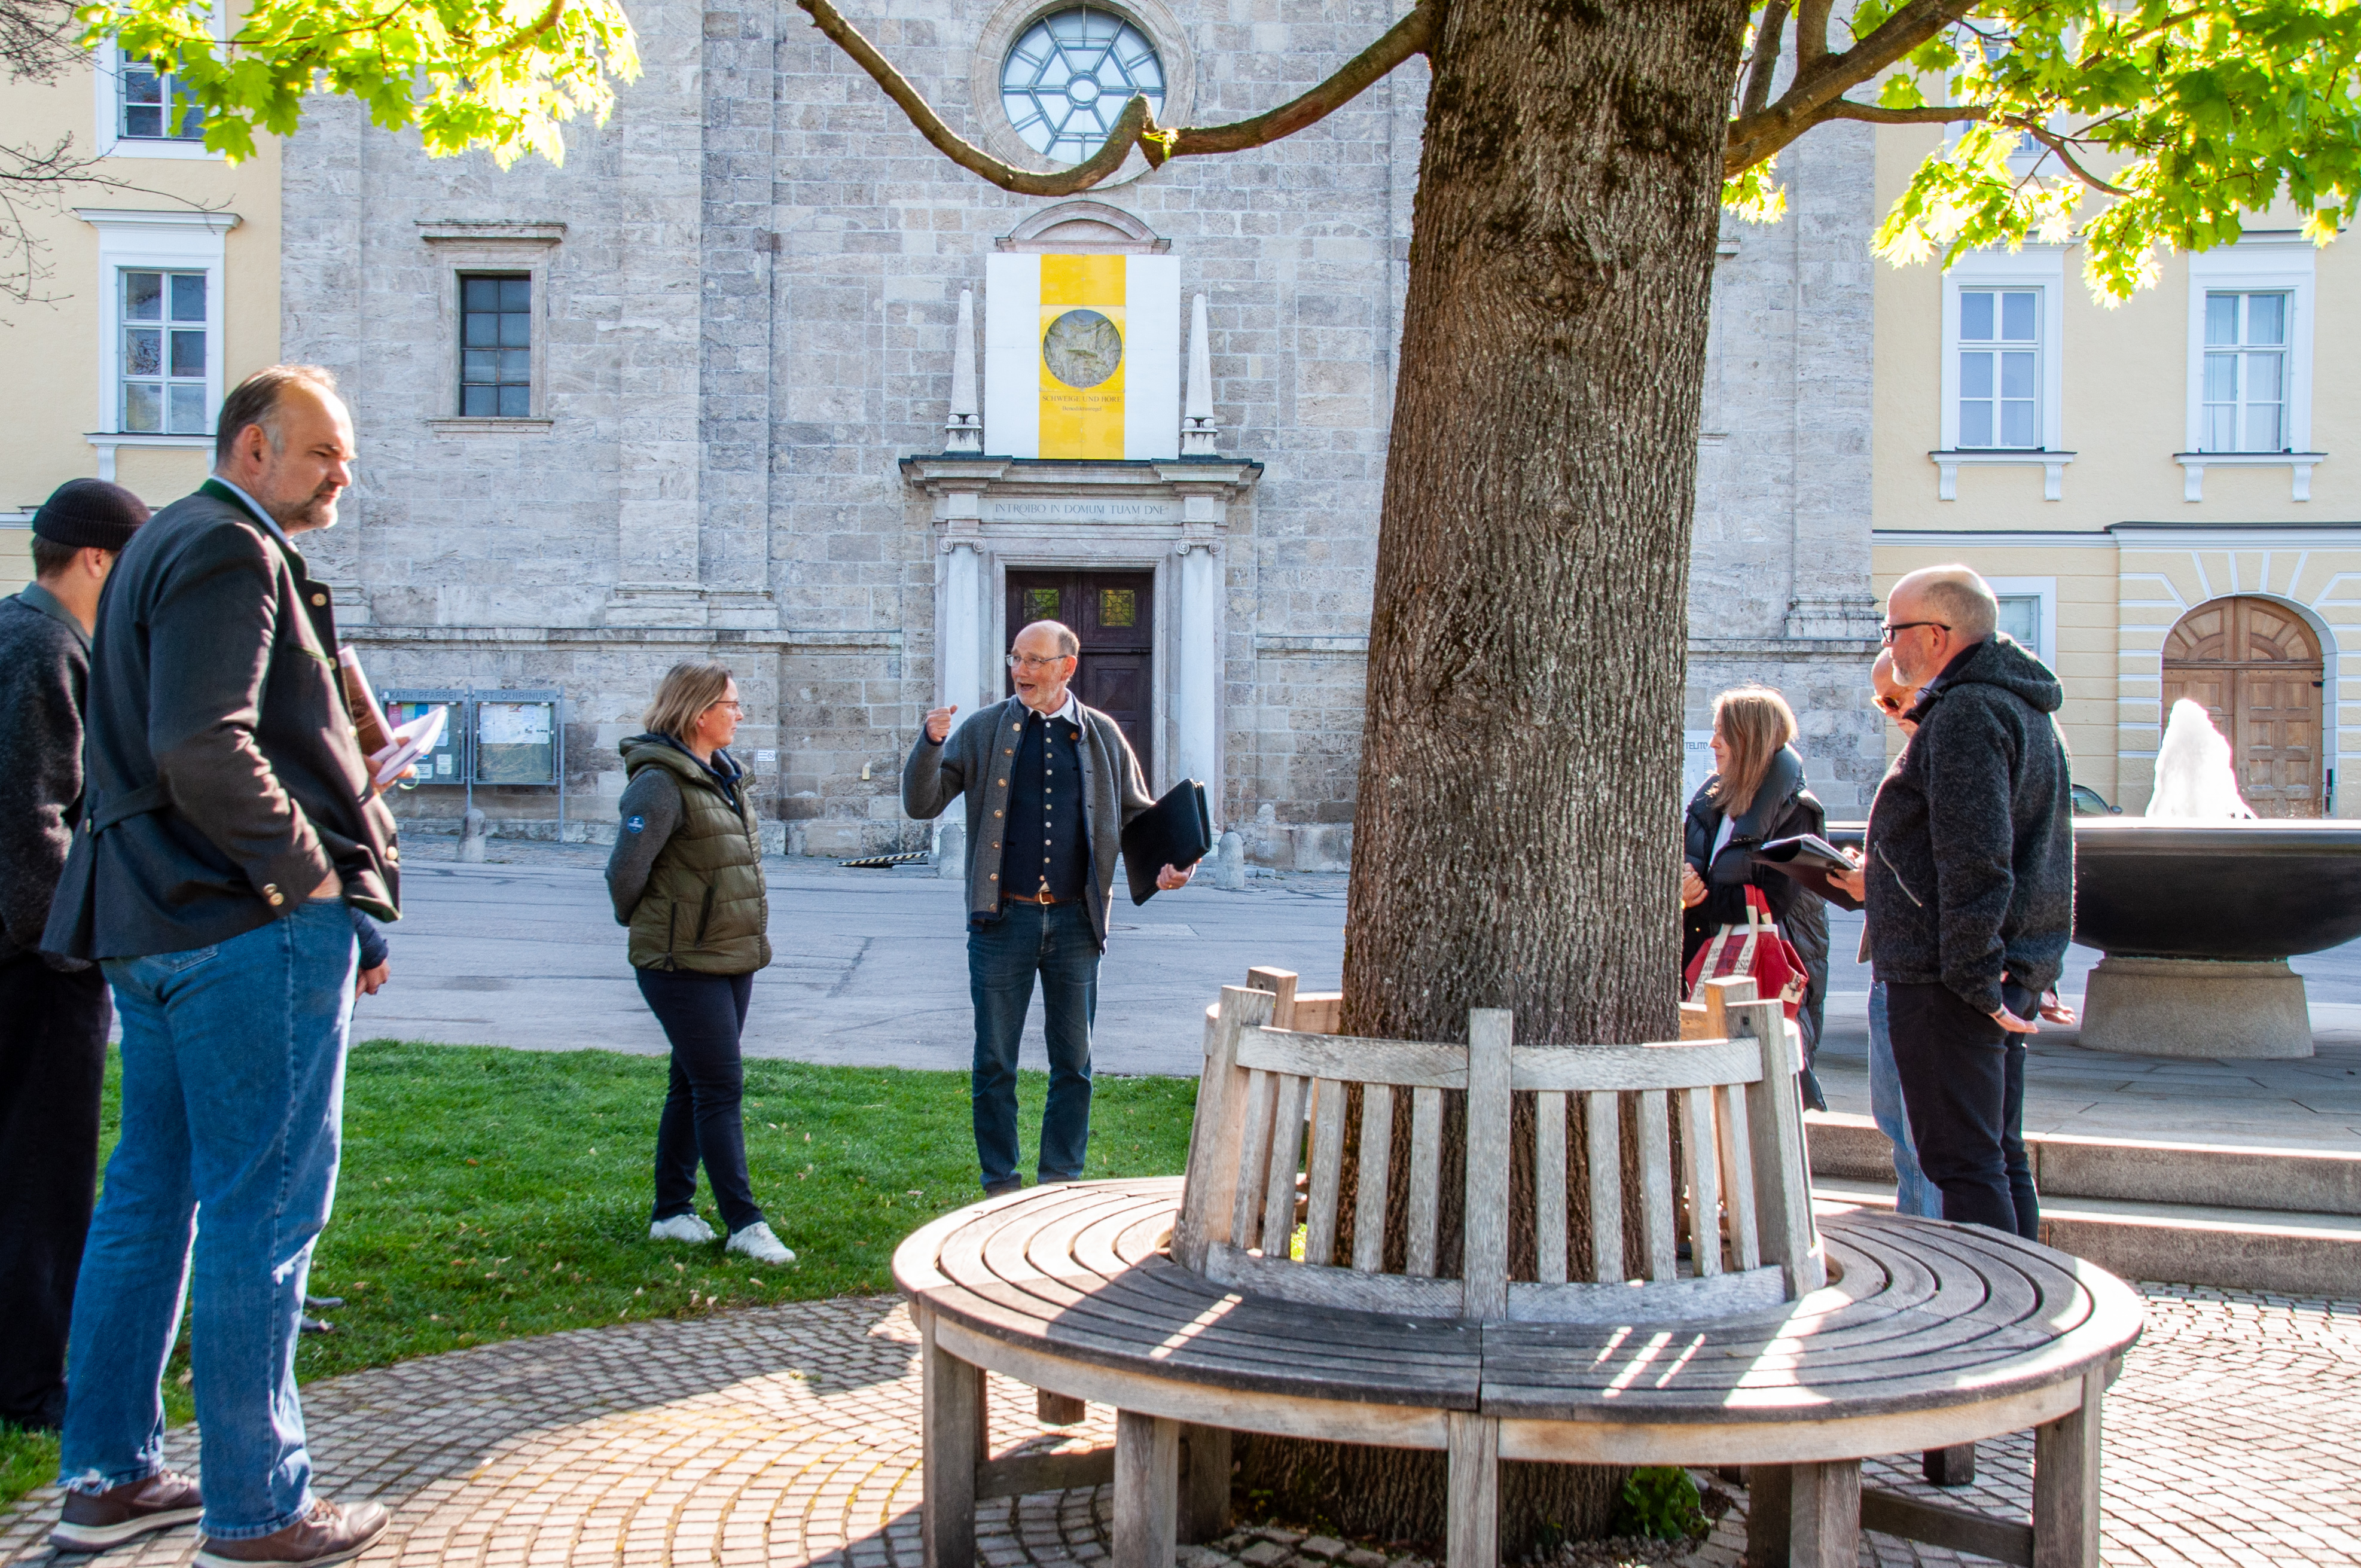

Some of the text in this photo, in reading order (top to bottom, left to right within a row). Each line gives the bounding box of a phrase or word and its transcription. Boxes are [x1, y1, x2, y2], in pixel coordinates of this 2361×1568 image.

[995, 503, 1047, 517] INTROIBO
[1050, 504, 1060, 513] IN
[1064, 505, 1105, 514] DOMUM
[1111, 505, 1140, 515] TUAM
[418, 691, 457, 700] PFARREI
[501, 691, 549, 700] QUIRINUS
